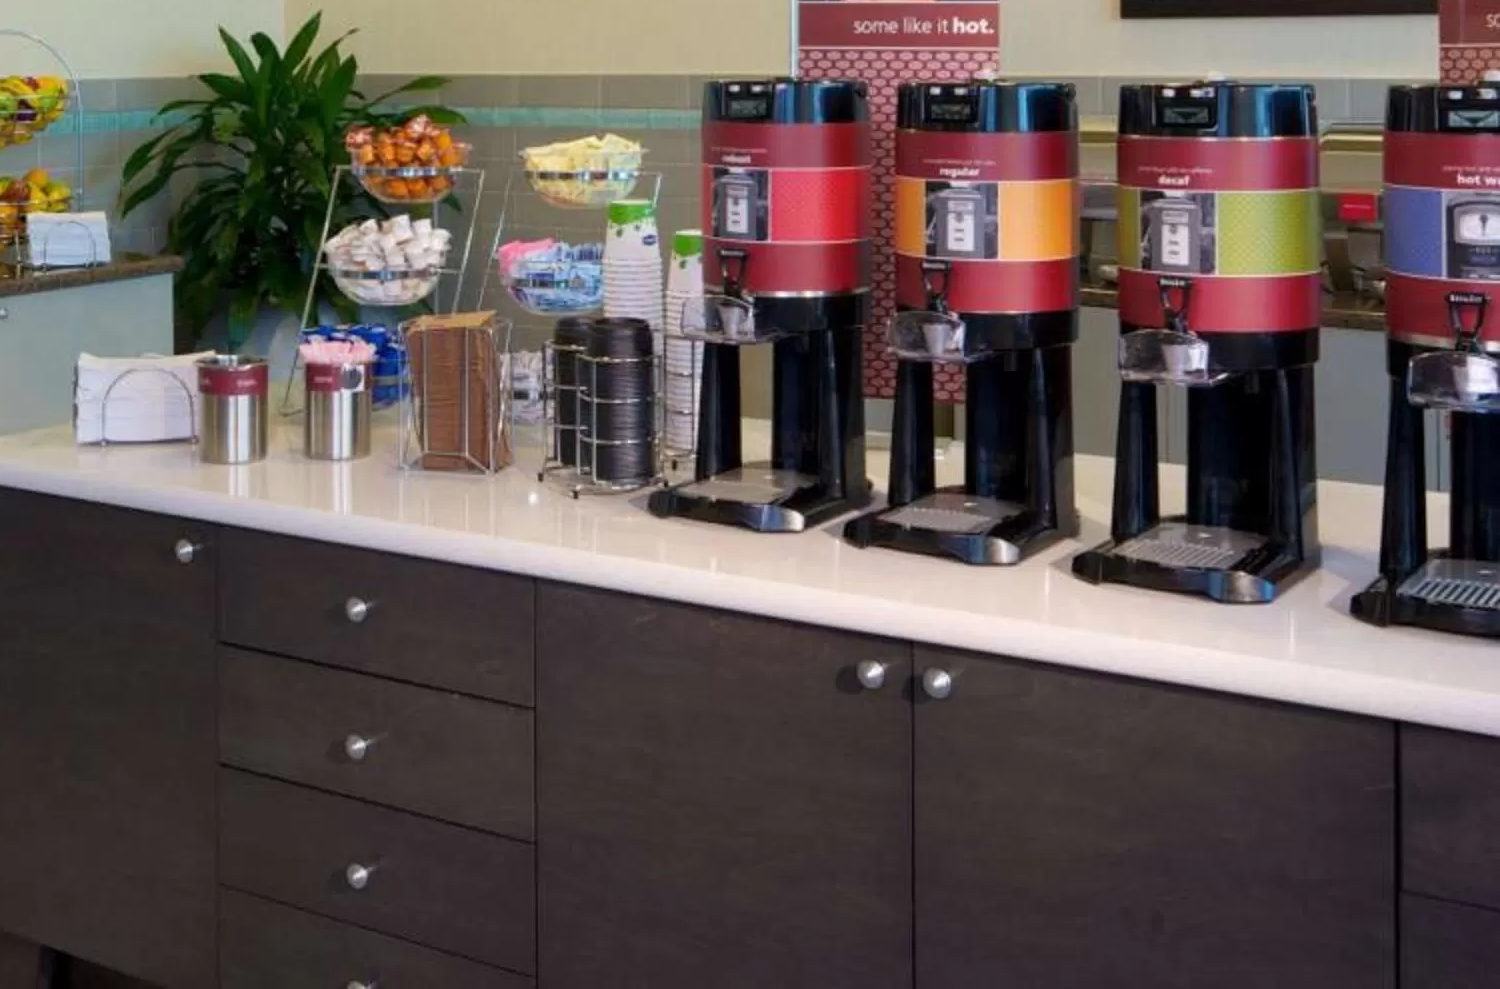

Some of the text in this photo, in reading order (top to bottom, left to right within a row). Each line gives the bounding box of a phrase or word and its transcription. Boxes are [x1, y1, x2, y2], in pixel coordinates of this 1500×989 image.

[853, 16, 995, 35] some like it hot.
[1456, 173, 1480, 186] hot
